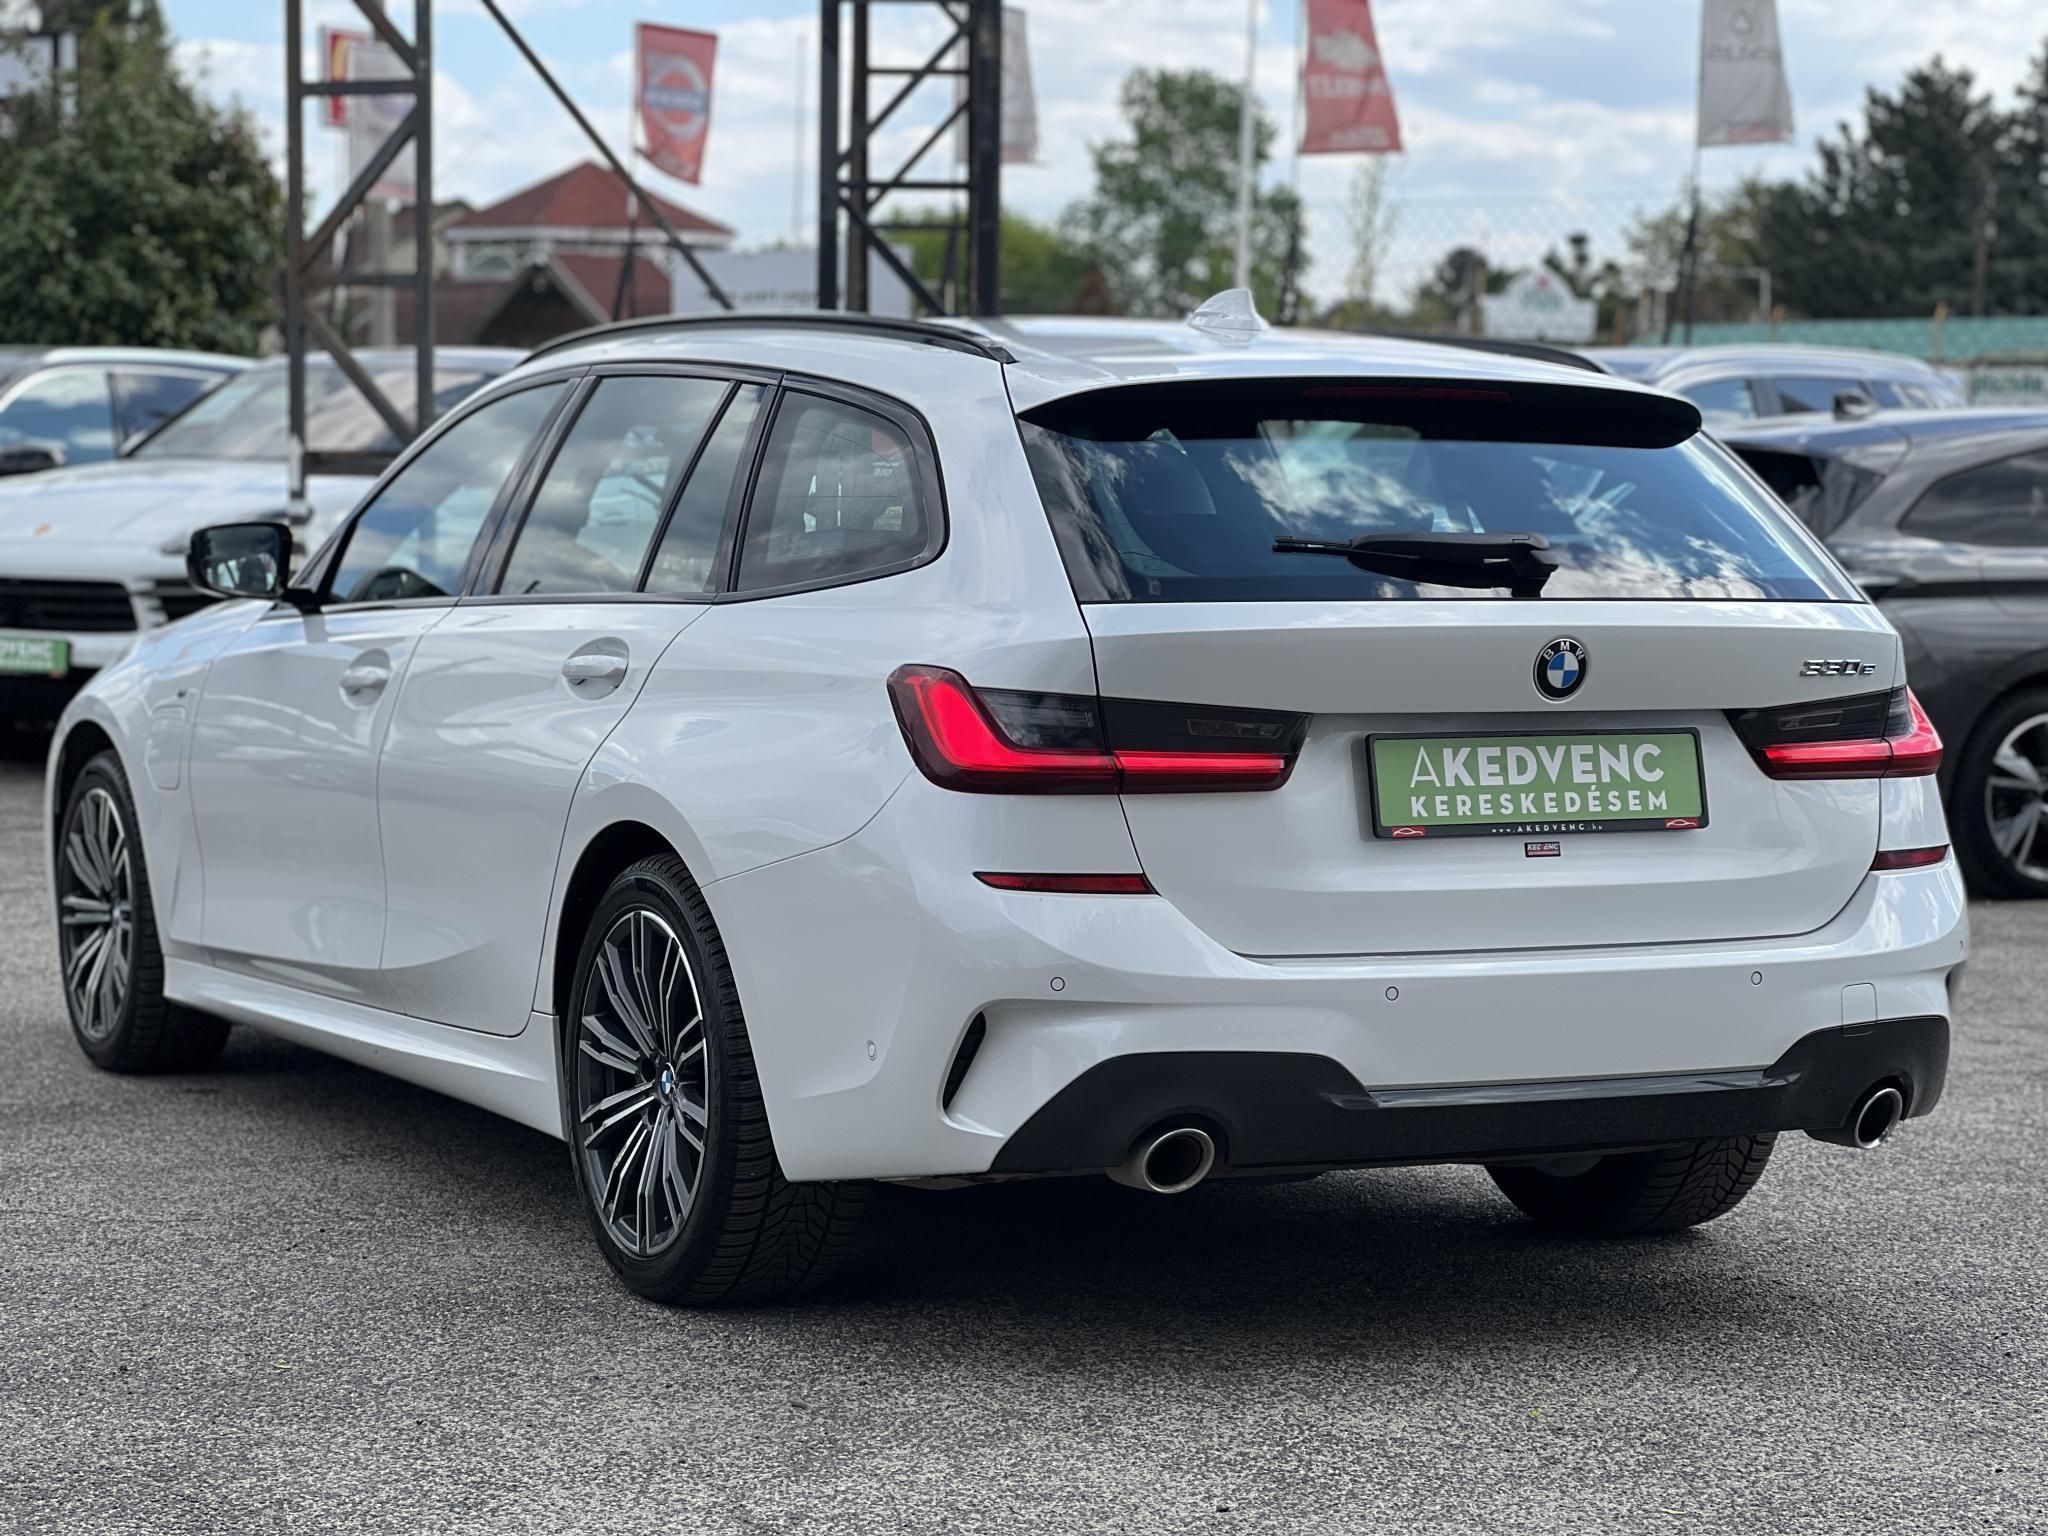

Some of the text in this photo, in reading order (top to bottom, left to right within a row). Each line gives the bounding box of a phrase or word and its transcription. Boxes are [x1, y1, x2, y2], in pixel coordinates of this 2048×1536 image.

[1542, 641, 1585, 661] BMW
[1410, 743, 1665, 788] AKEDVENC
[1410, 785, 1668, 818] KERESKEDÉSEM
[1491, 823, 1603, 833] www.AKEDVENC.hu
